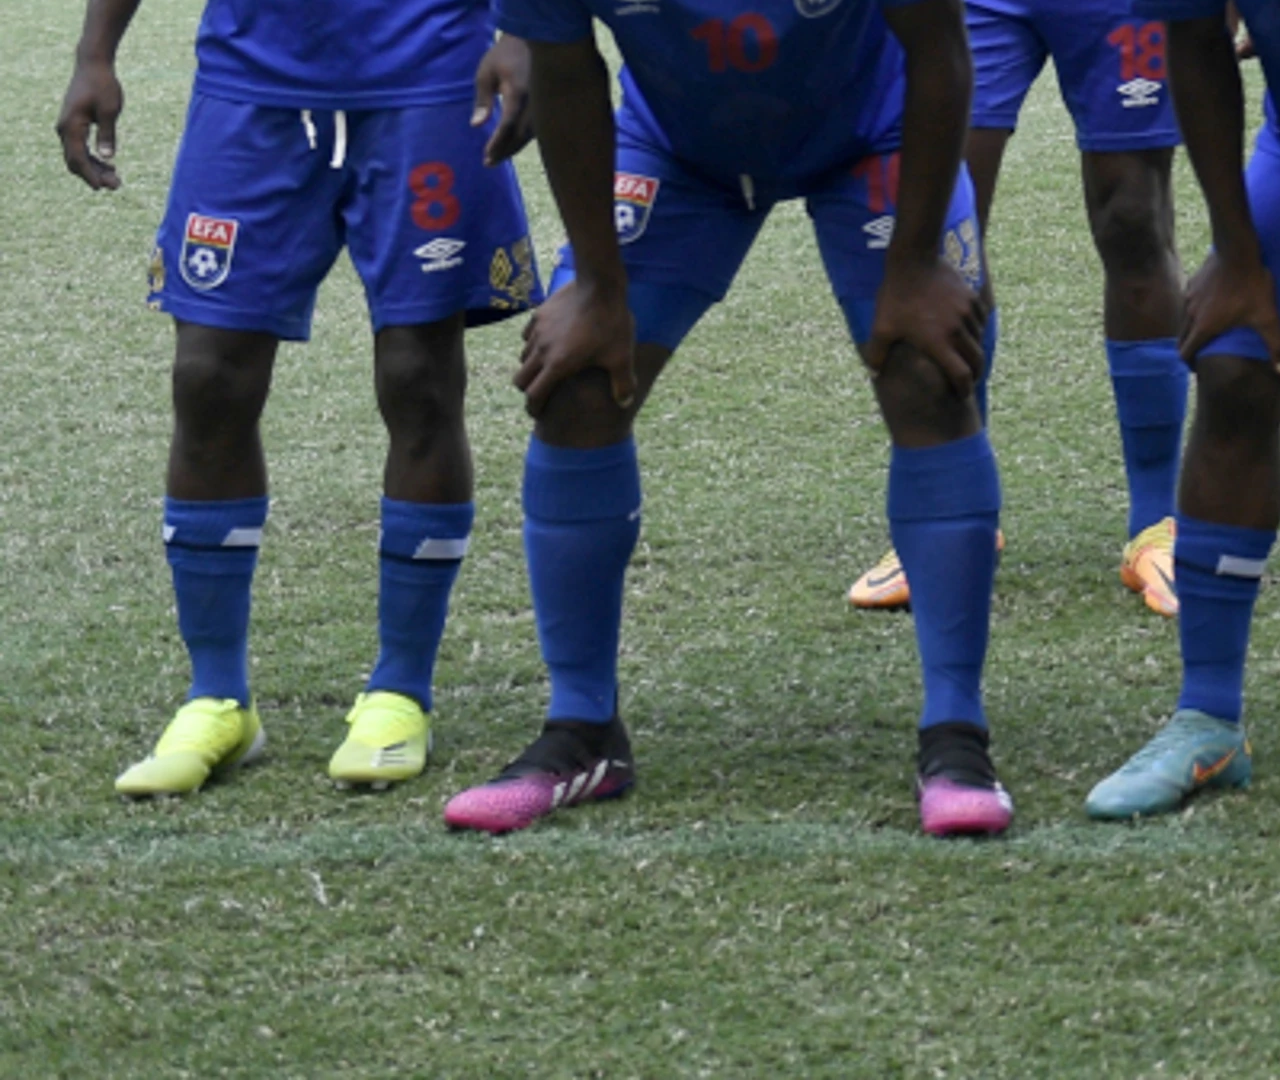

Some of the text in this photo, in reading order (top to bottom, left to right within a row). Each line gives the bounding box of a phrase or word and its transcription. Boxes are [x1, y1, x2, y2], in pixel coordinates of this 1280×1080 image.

[691, 12, 778, 73] 10
[1107, 21, 1168, 80] 18
[408, 162, 461, 231] 8
[193, 218, 229, 241] EFA
